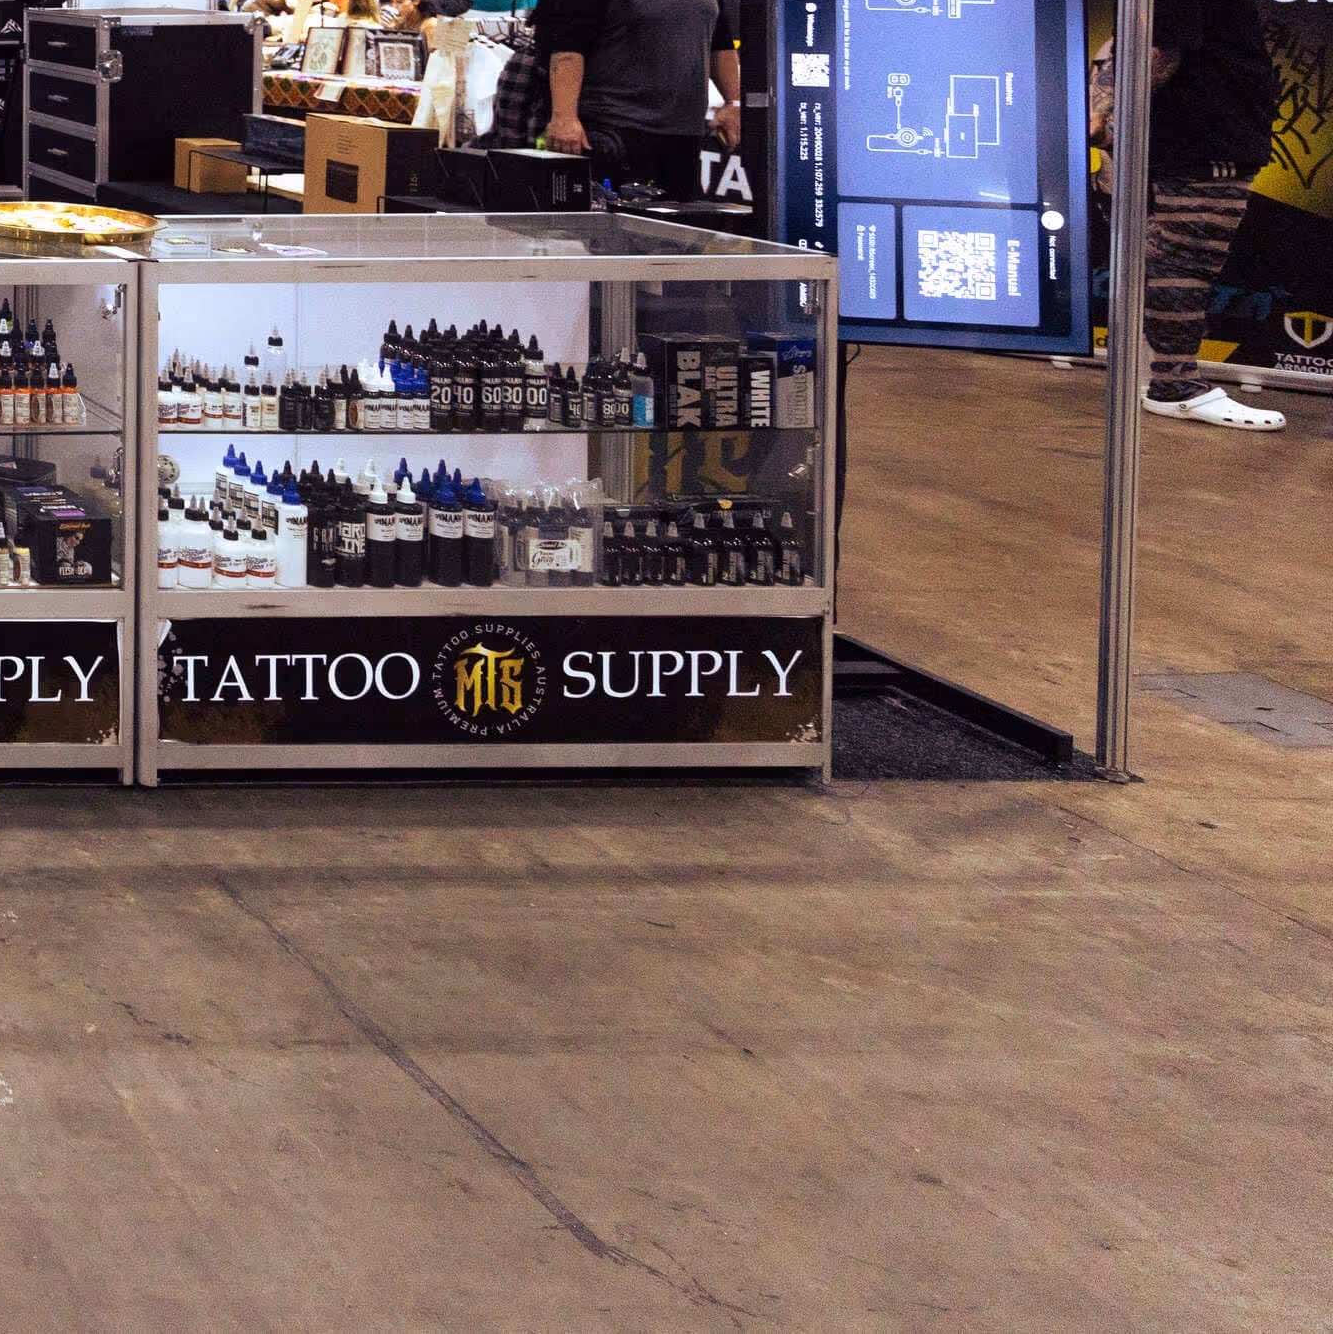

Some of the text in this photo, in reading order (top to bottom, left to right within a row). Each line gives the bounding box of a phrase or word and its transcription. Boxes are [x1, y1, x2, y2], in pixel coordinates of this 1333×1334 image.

[432, 387, 451, 404] 20
[453, 387, 473, 404] 40
[483, 387, 501, 404] 60
[677, 351, 701, 427] BLAK
[716, 366, 738, 426] ULTRA
[750, 370, 770, 427] WHITE
[173, 650, 801, 701] TATTOO SUPPLY
[432, 624, 541, 679] TATTOO SUPPLIES
[454, 642, 525, 717] MTS
